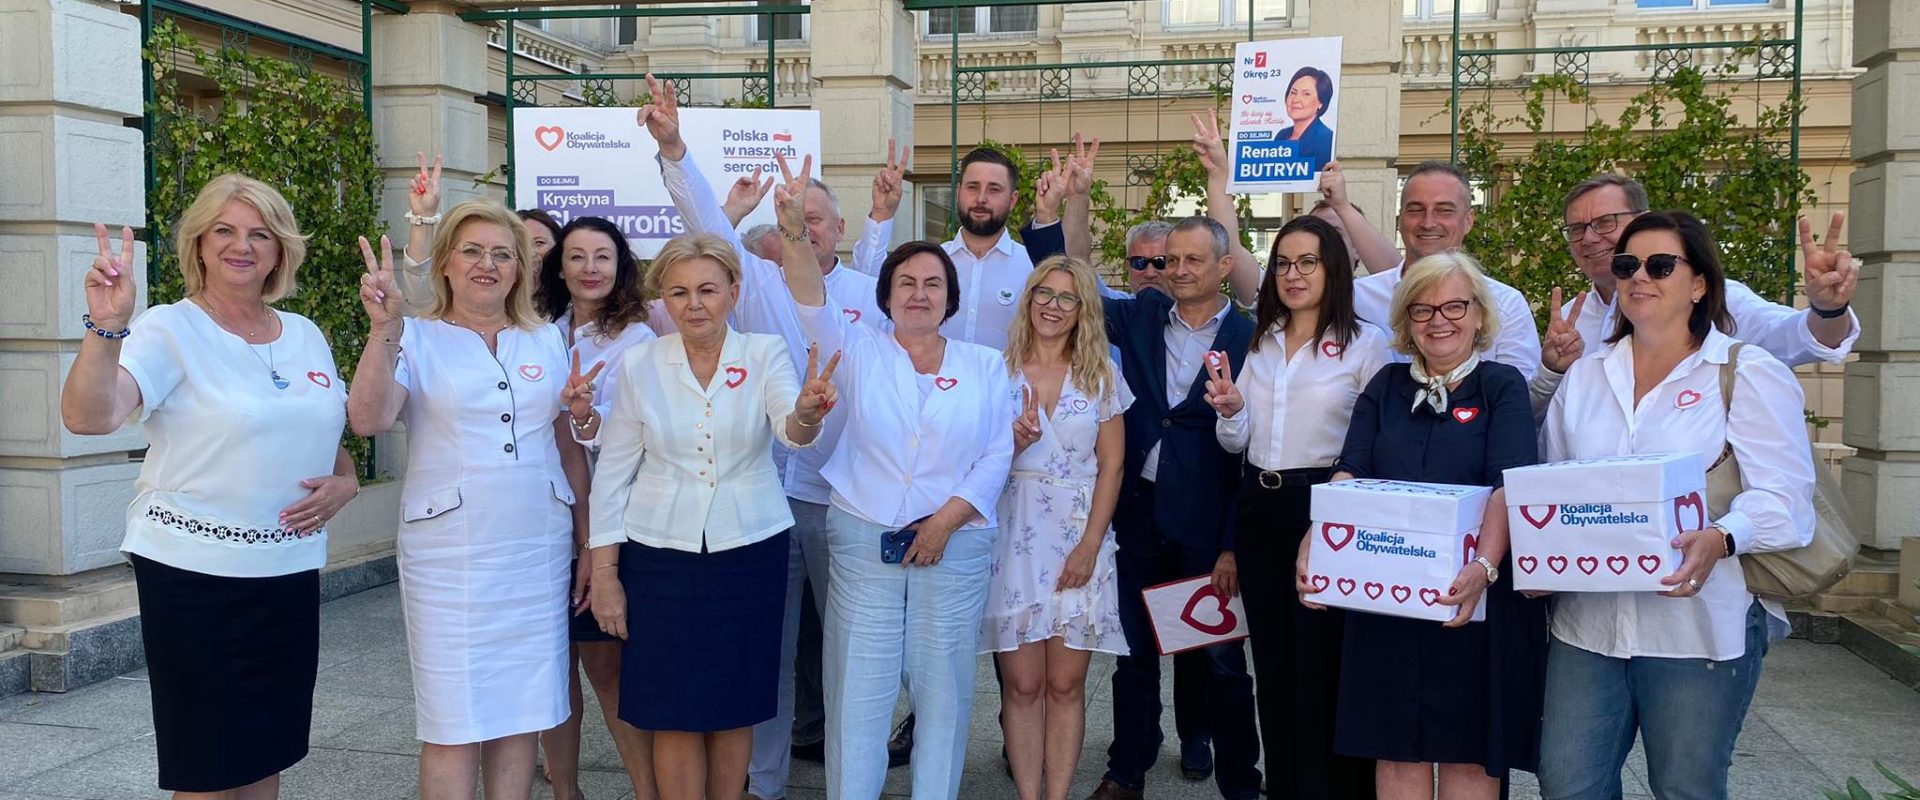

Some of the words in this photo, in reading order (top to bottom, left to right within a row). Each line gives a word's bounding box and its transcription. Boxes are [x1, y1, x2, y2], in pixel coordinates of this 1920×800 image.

[1244, 57, 1254, 65] Nr
[1257, 55, 1265, 65] 7
[1243, 70, 1268, 80] Okręg
[1270, 69, 1281, 77] 23
[566, 131, 605, 142] Koalicja
[723, 129, 768, 142] Polska
[566, 140, 630, 150] Obywatelska
[723, 146, 736, 156] w
[738, 145, 796, 159] naszych
[1241, 145, 1292, 159] Renata
[1240, 161, 1309, 178] BUTRYN
[552, 177, 576, 185] SEJMU
[543, 192, 610, 208] Krystyna
[1560, 503, 1612, 516] Koalicja
[1560, 512, 1649, 527] Obywatelska
[1357, 529, 1405, 546] Koalicja
[1356, 540, 1436, 558] Obywatelska
